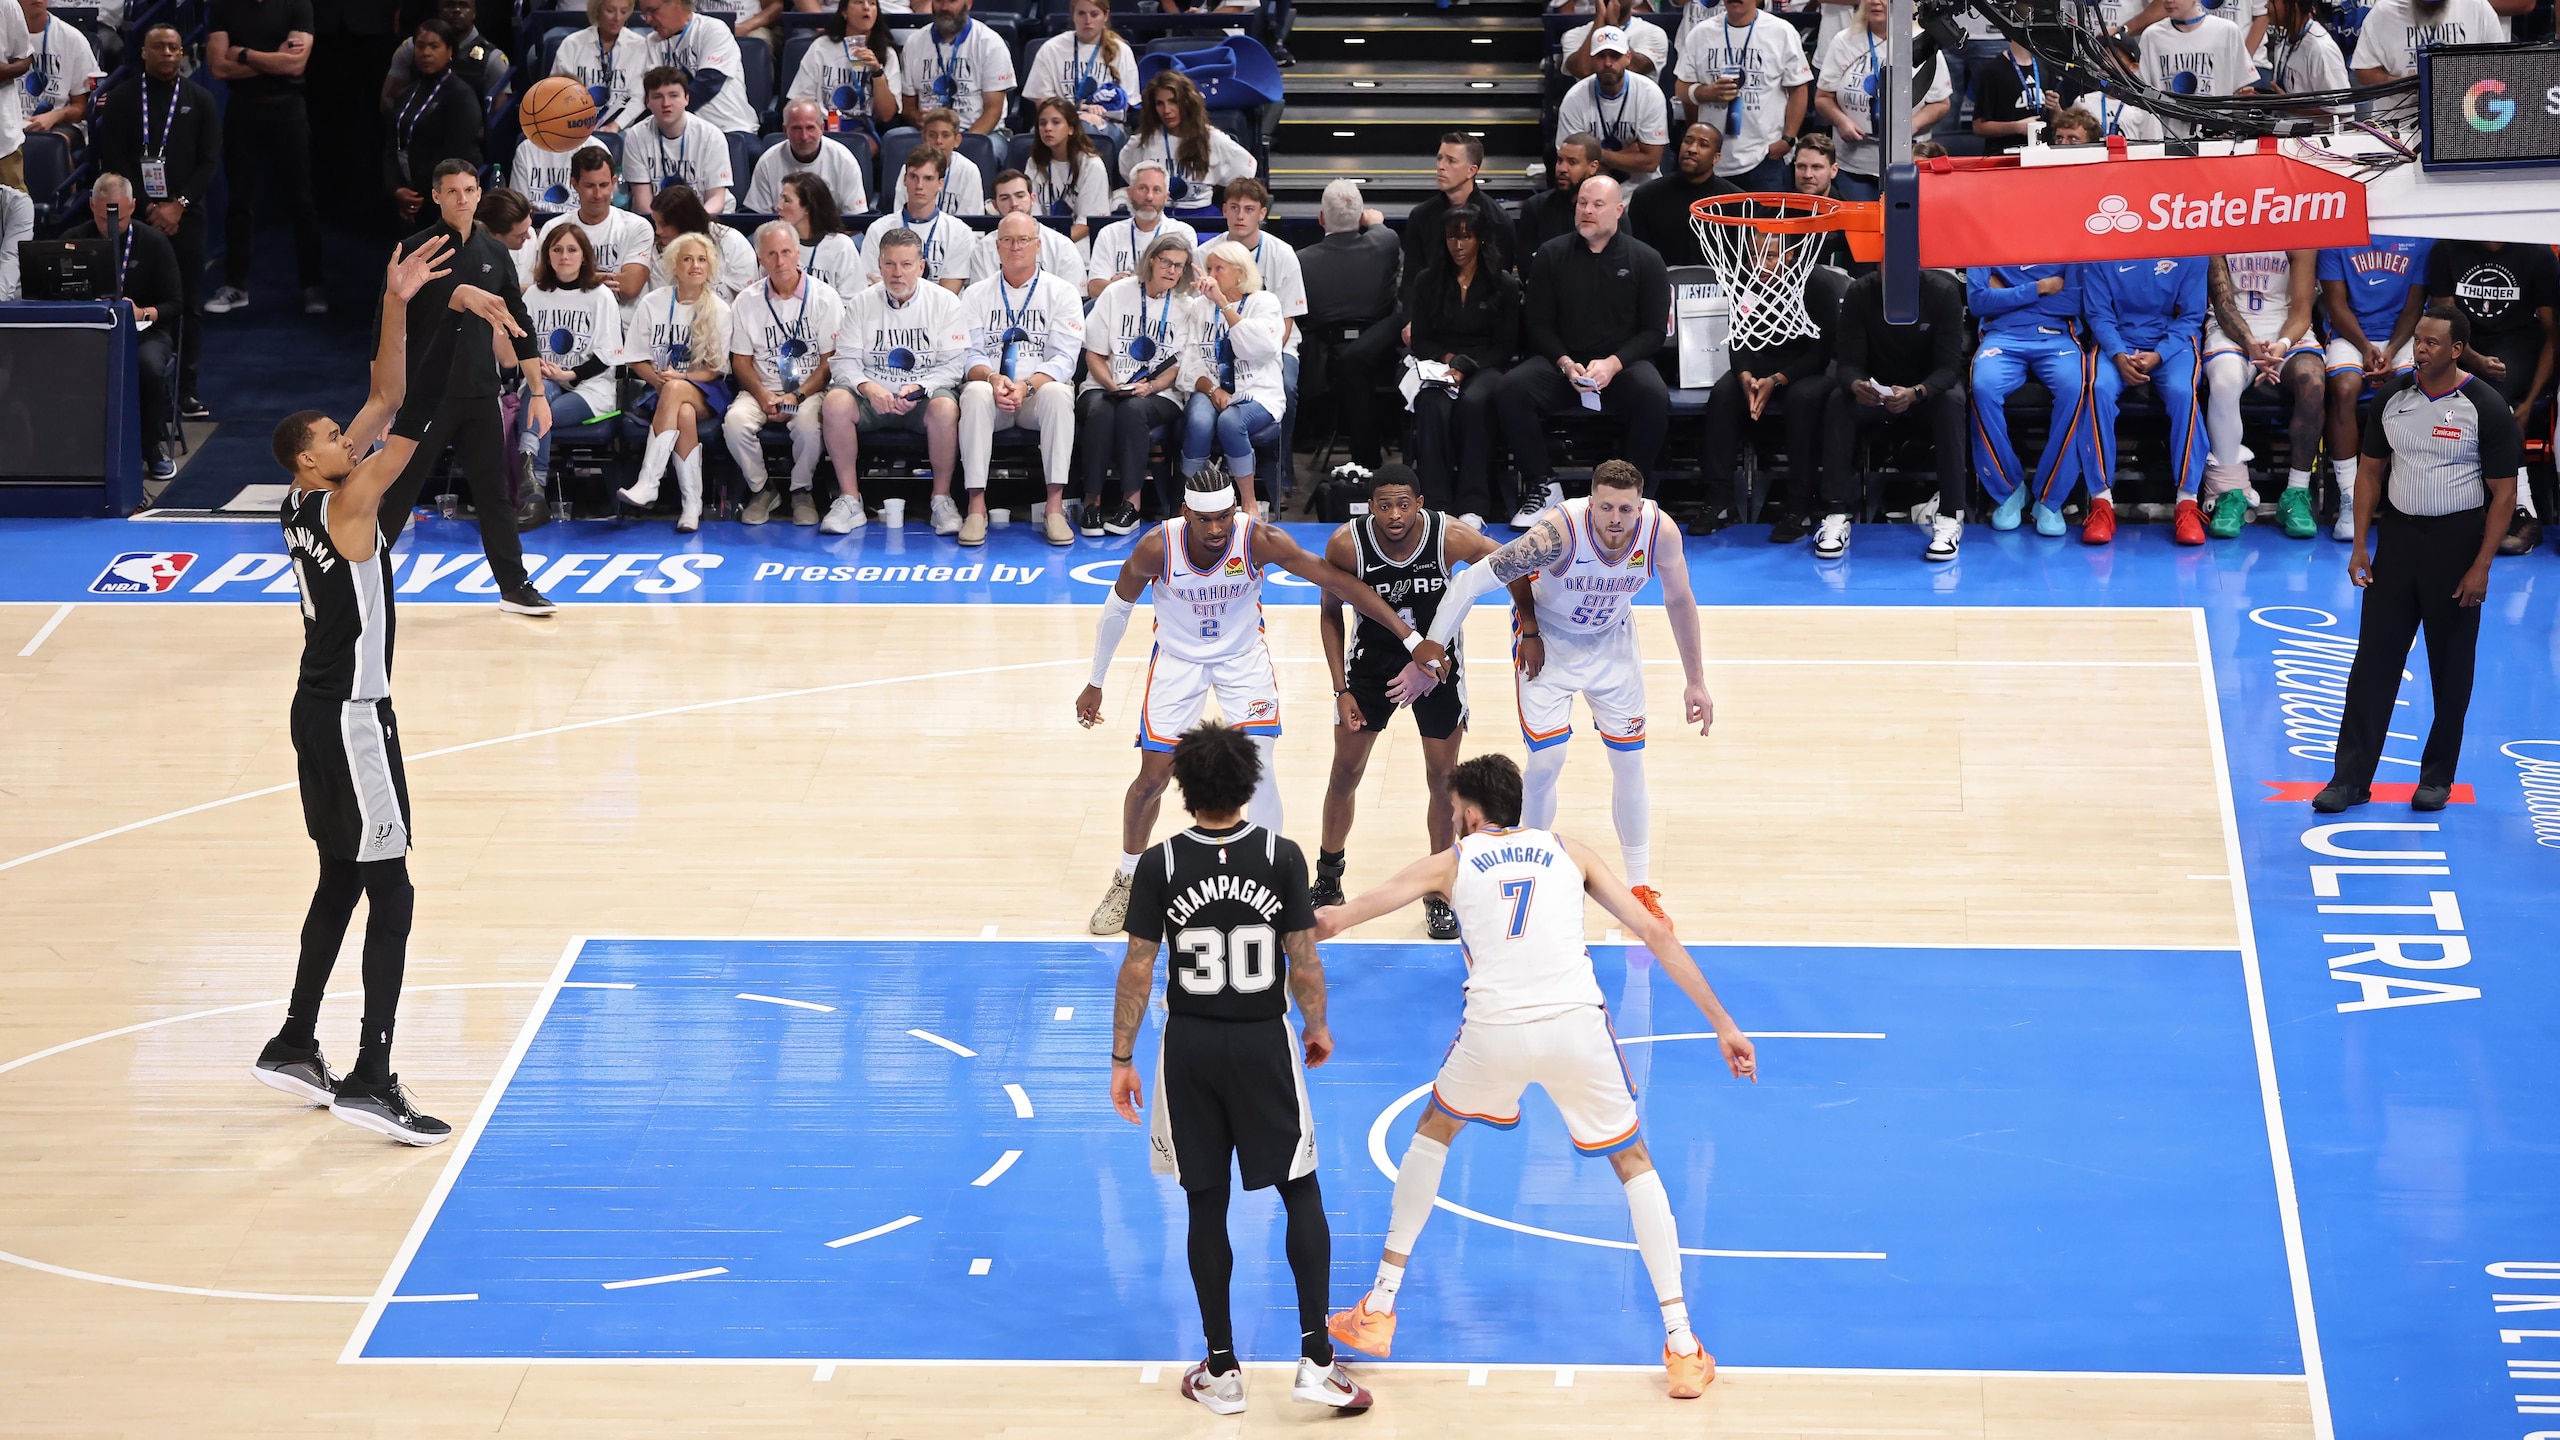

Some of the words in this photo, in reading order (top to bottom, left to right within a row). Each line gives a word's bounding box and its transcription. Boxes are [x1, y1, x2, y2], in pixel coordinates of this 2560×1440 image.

[1597, 32, 1619, 43] OKC
[2160, 53, 2215, 79] PLAYOFFS
[2201, 82, 2211, 94] 26
[2147, 191, 2248, 231] State
[2250, 187, 2347, 225] Farm
[2229, 256, 2288, 274] KLAHOMA
[2351, 251, 2410, 275] THUNDER
[2241, 274, 2269, 290] CITY
[2463, 286, 2514, 298] THUNDER
[2247, 291, 2264, 314] 6
[536, 309, 592, 335] PLAYOFFS
[990, 308, 1047, 334] PLAYOFFS
[577, 340, 588, 352] 26
[874, 328, 931, 352] PLAYOFFS
[919, 354, 931, 368] 26
[2433, 428, 2461, 438] Emirates
[188, 552, 724, 594] PLYOFFS
[753, 561, 984, 583] Presented
[988, 563, 1046, 585] by
[101, 582, 142, 592] NBA
[1192, 601, 1228, 617] CITY
[1582, 594, 1620, 607] CITY
[1569, 606, 1617, 626] 55
[1200, 619, 1220, 639] 2
[1471, 847, 1555, 874] HOLMGREN
[1166, 874, 1284, 927] CHAMPAGNIE
[1499, 876, 1536, 940] 7
[2300, 822, 2483, 1014] ULTRA
[1175, 923, 1276, 995] 30
